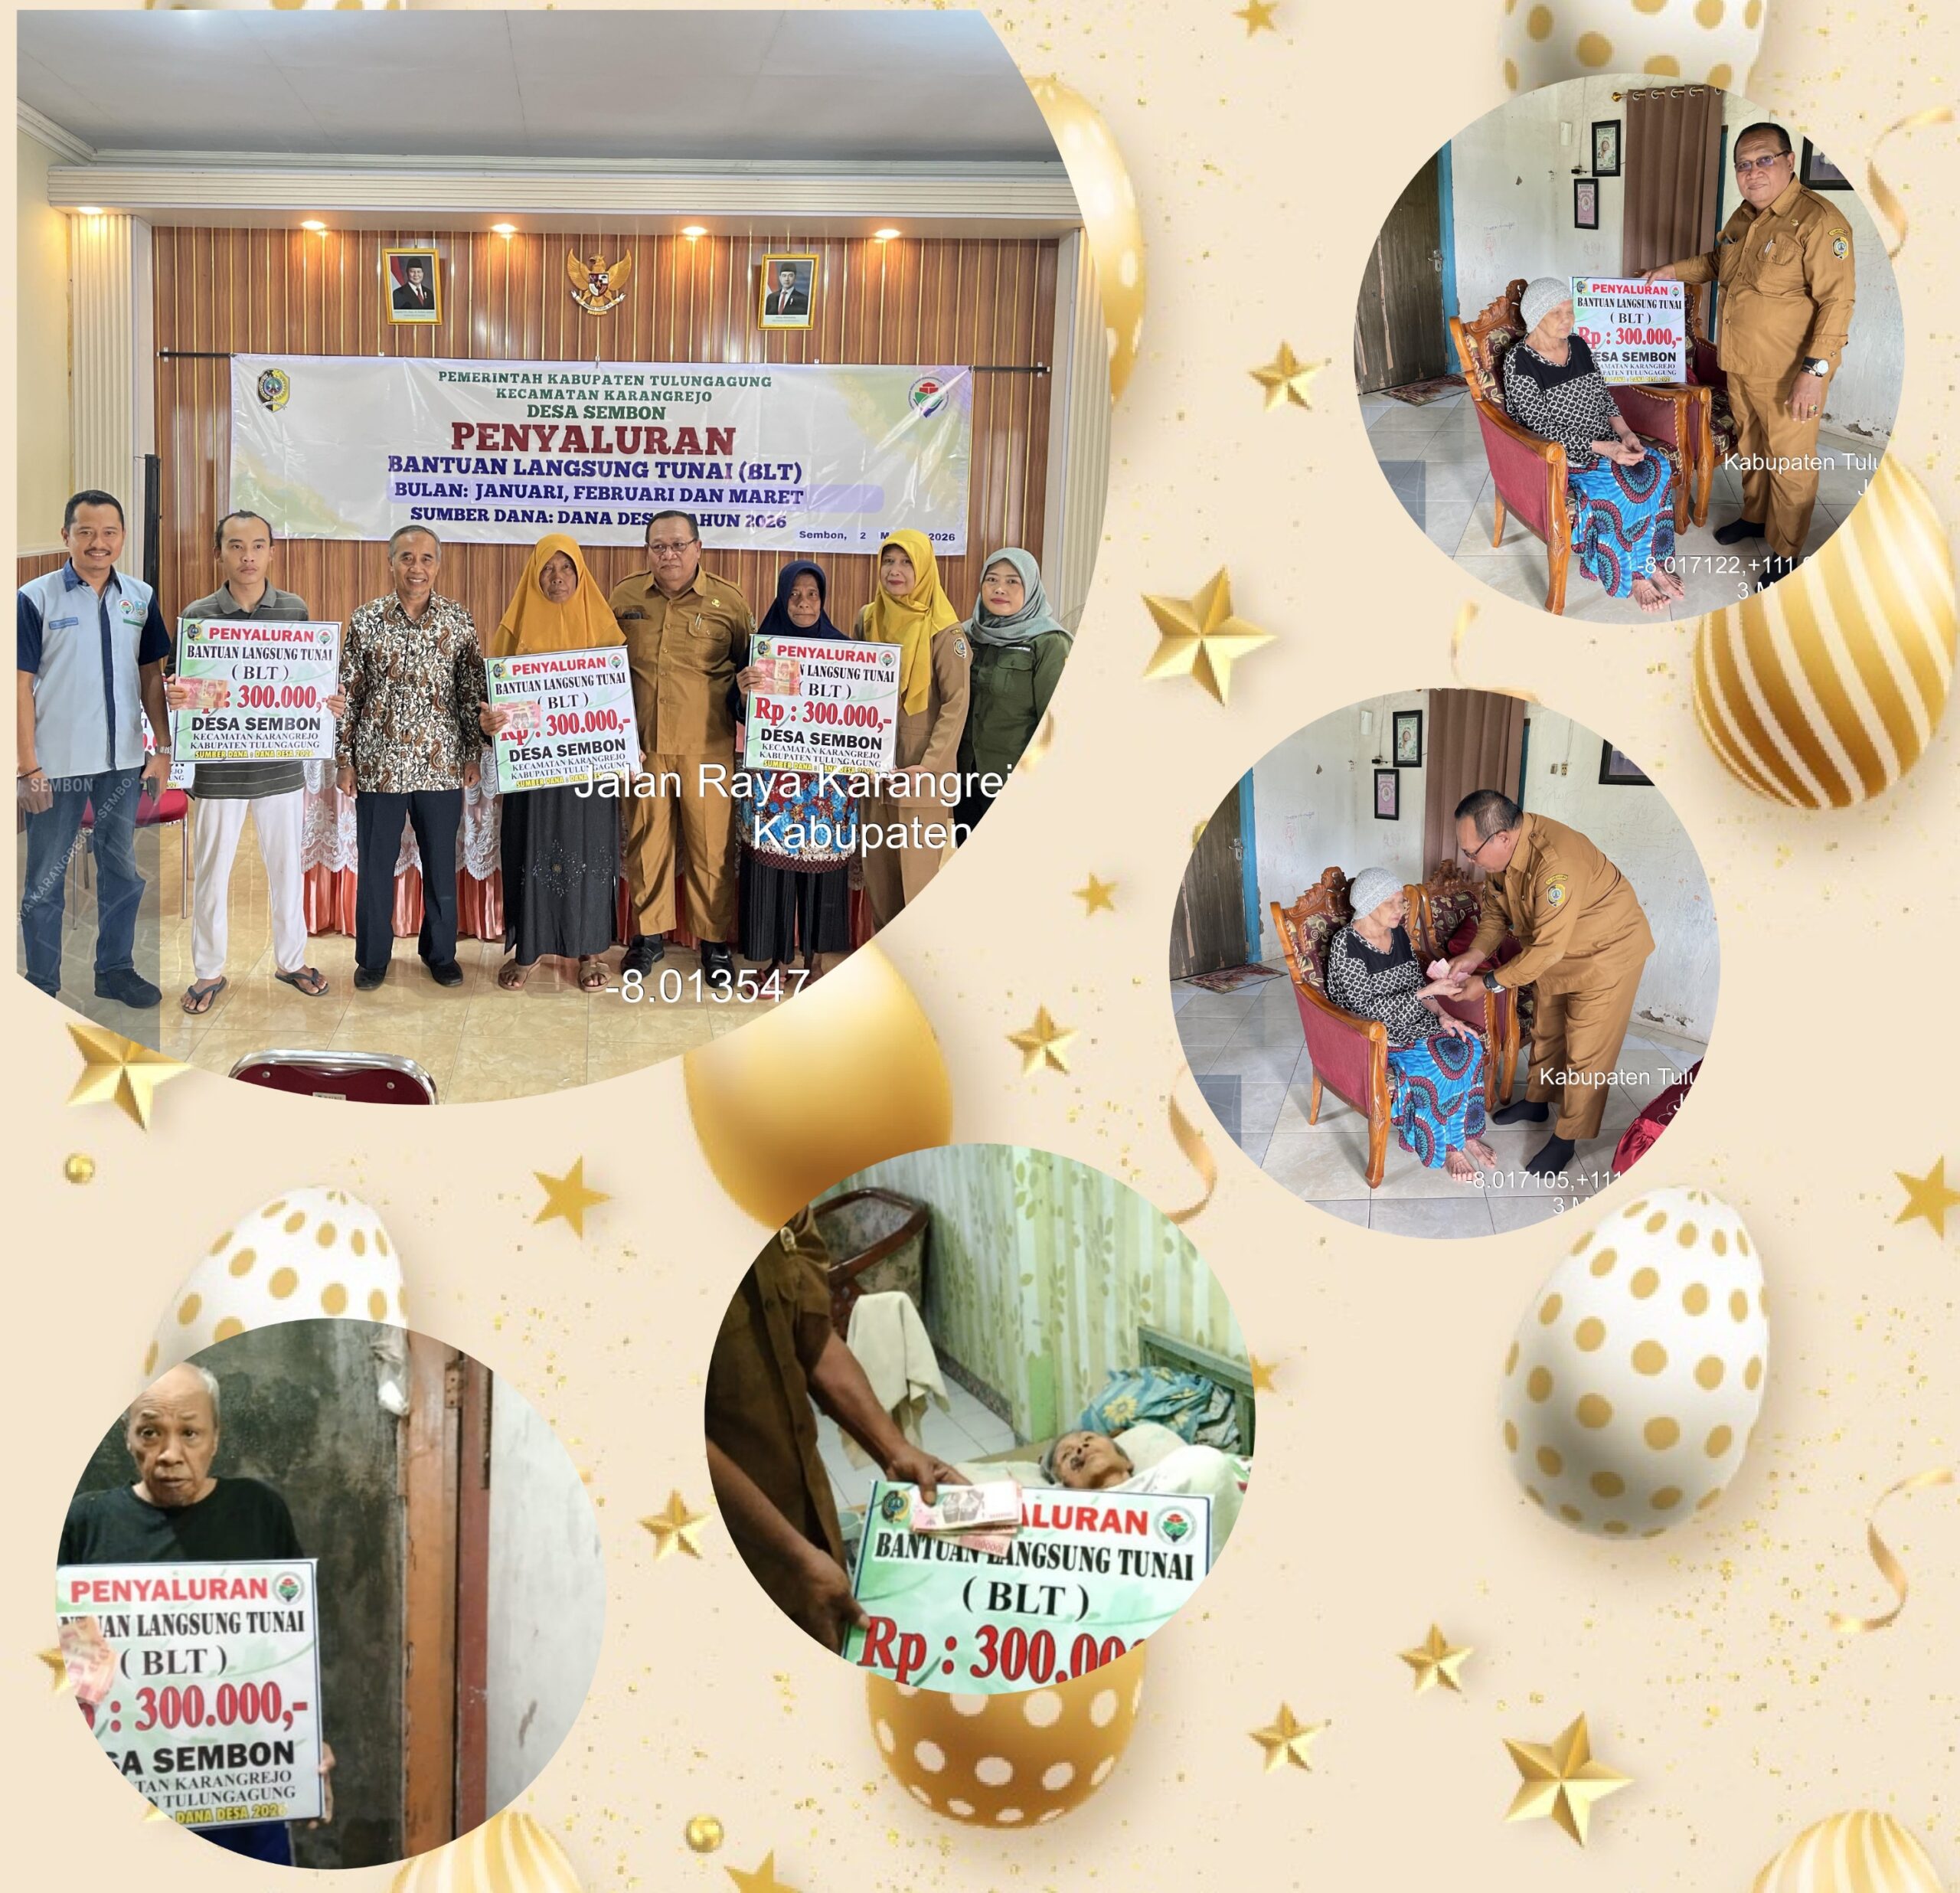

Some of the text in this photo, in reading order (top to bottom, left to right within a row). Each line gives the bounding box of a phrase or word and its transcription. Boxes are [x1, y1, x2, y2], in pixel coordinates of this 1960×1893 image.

[1592, 284, 1668, 296] PENYALURAN
[1577, 297, 1682, 310] BANTUAN LANGSUNG TUNAI
[1577, 326, 1602, 350] Rp
[1615, 327, 1683, 349] 300.000,-
[1594, 351, 1677, 362] ESA SEMBON
[439, 371, 772, 387] PEMERINTAH KABUPATEN TULUNGAGUNG
[496, 387, 712, 404] KECAMATAN KARANGREJO
[527, 404, 666, 420] DESA SEMBON
[451, 422, 737, 456] PENYALURAN
[388, 455, 802, 484] BANTUAN LANGSUNG TUNAI (BLT)
[395, 482, 804, 505] BULAN: JANUARI, FEBRUARI DAN MARET
[410, 506, 787, 528] SUMBER DANA: DANA DES AHUN 2026
[799, 530, 956, 541] Sembon, 2 2026
[209, 627, 314, 642] PENYALURAN
[187, 645, 332, 661] BANTUAN LANGSUNG TUNAI
[777, 645, 877, 664] PENYALURAN
[511, 656, 606, 676] PENYALURAN
[807, 664, 861, 680] LANGSUNG
[863, 669, 895, 683] TUNAI
[495, 672, 626, 695] BANTUAN LANGSUNG TUNAI
[191, 717, 321, 731] DESA SEMBON
[546, 708, 631, 737] 300.000,-
[754, 697, 784, 726] Rp
[802, 701, 892, 733] 300.000,-
[250, 741, 320, 749] TULUNGAGUNG
[760, 728, 883, 750] DESA SEMBON
[194, 750, 227, 759] SUMBER
[254, 750, 276, 758] DANA
[509, 738, 626, 763] DESA SEMBON
[760, 750, 881, 767] KABUPATEN TULUNGAGUNG
[762, 743, 880, 759] KECAMATAN KARANGREJO
[512, 754, 626, 772] KECAMATAN KARANGREJO
[763, 760, 792, 770] SUMBER
[794, 762, 812, 771] DANA
[511, 768, 562, 780] KABUPATEN
[516, 778, 544, 788] SUMBER
[545, 777, 565, 786] DANA
[570, 773, 589, 783] DANA
[1117, 1548, 1194, 1581] TUNAI
[70, 1578, 268, 1603] PENYALURAN
[137, 1612, 241, 1637] LANGSUNG
[246, 1610, 305, 1633] TUNAI
[857, 1615, 927, 1685] Rp
[135, 1681, 308, 1732] 300.000,-
[152, 1740, 295, 1774] SEMBON
[175, 1770, 292, 1791] KARANGREJO
[163, 1786, 296, 1808] TULUNGAGUNG
[175, 1803, 286, 1824] DANA DESA 2026
